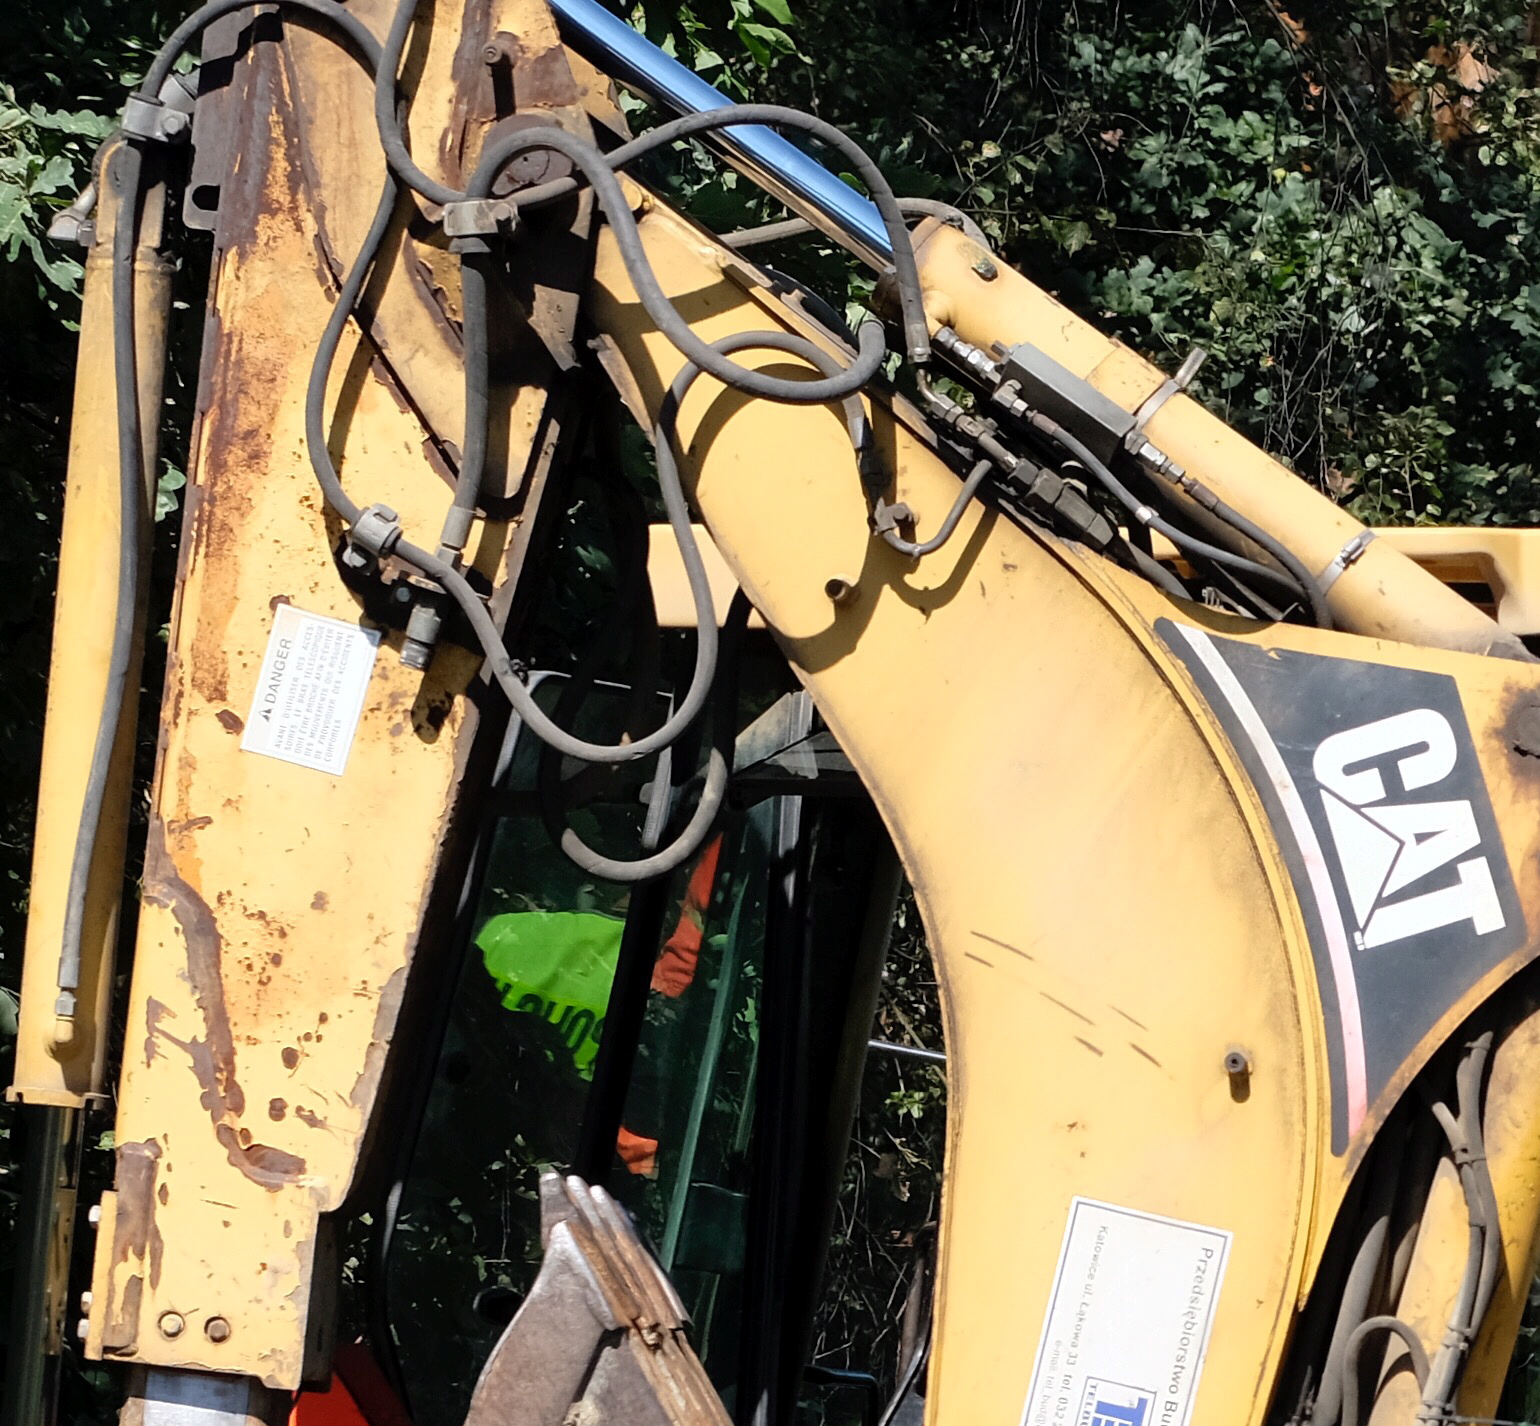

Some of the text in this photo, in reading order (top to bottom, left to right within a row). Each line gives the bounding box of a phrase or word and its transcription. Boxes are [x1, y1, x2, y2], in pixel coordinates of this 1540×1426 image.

[263, 637, 291, 704] DANGER
[1312, 708, 1506, 950] CAT
[1085, 1224, 1109, 1281] Katowice
[1053, 1396, 1068, 1420] 032
